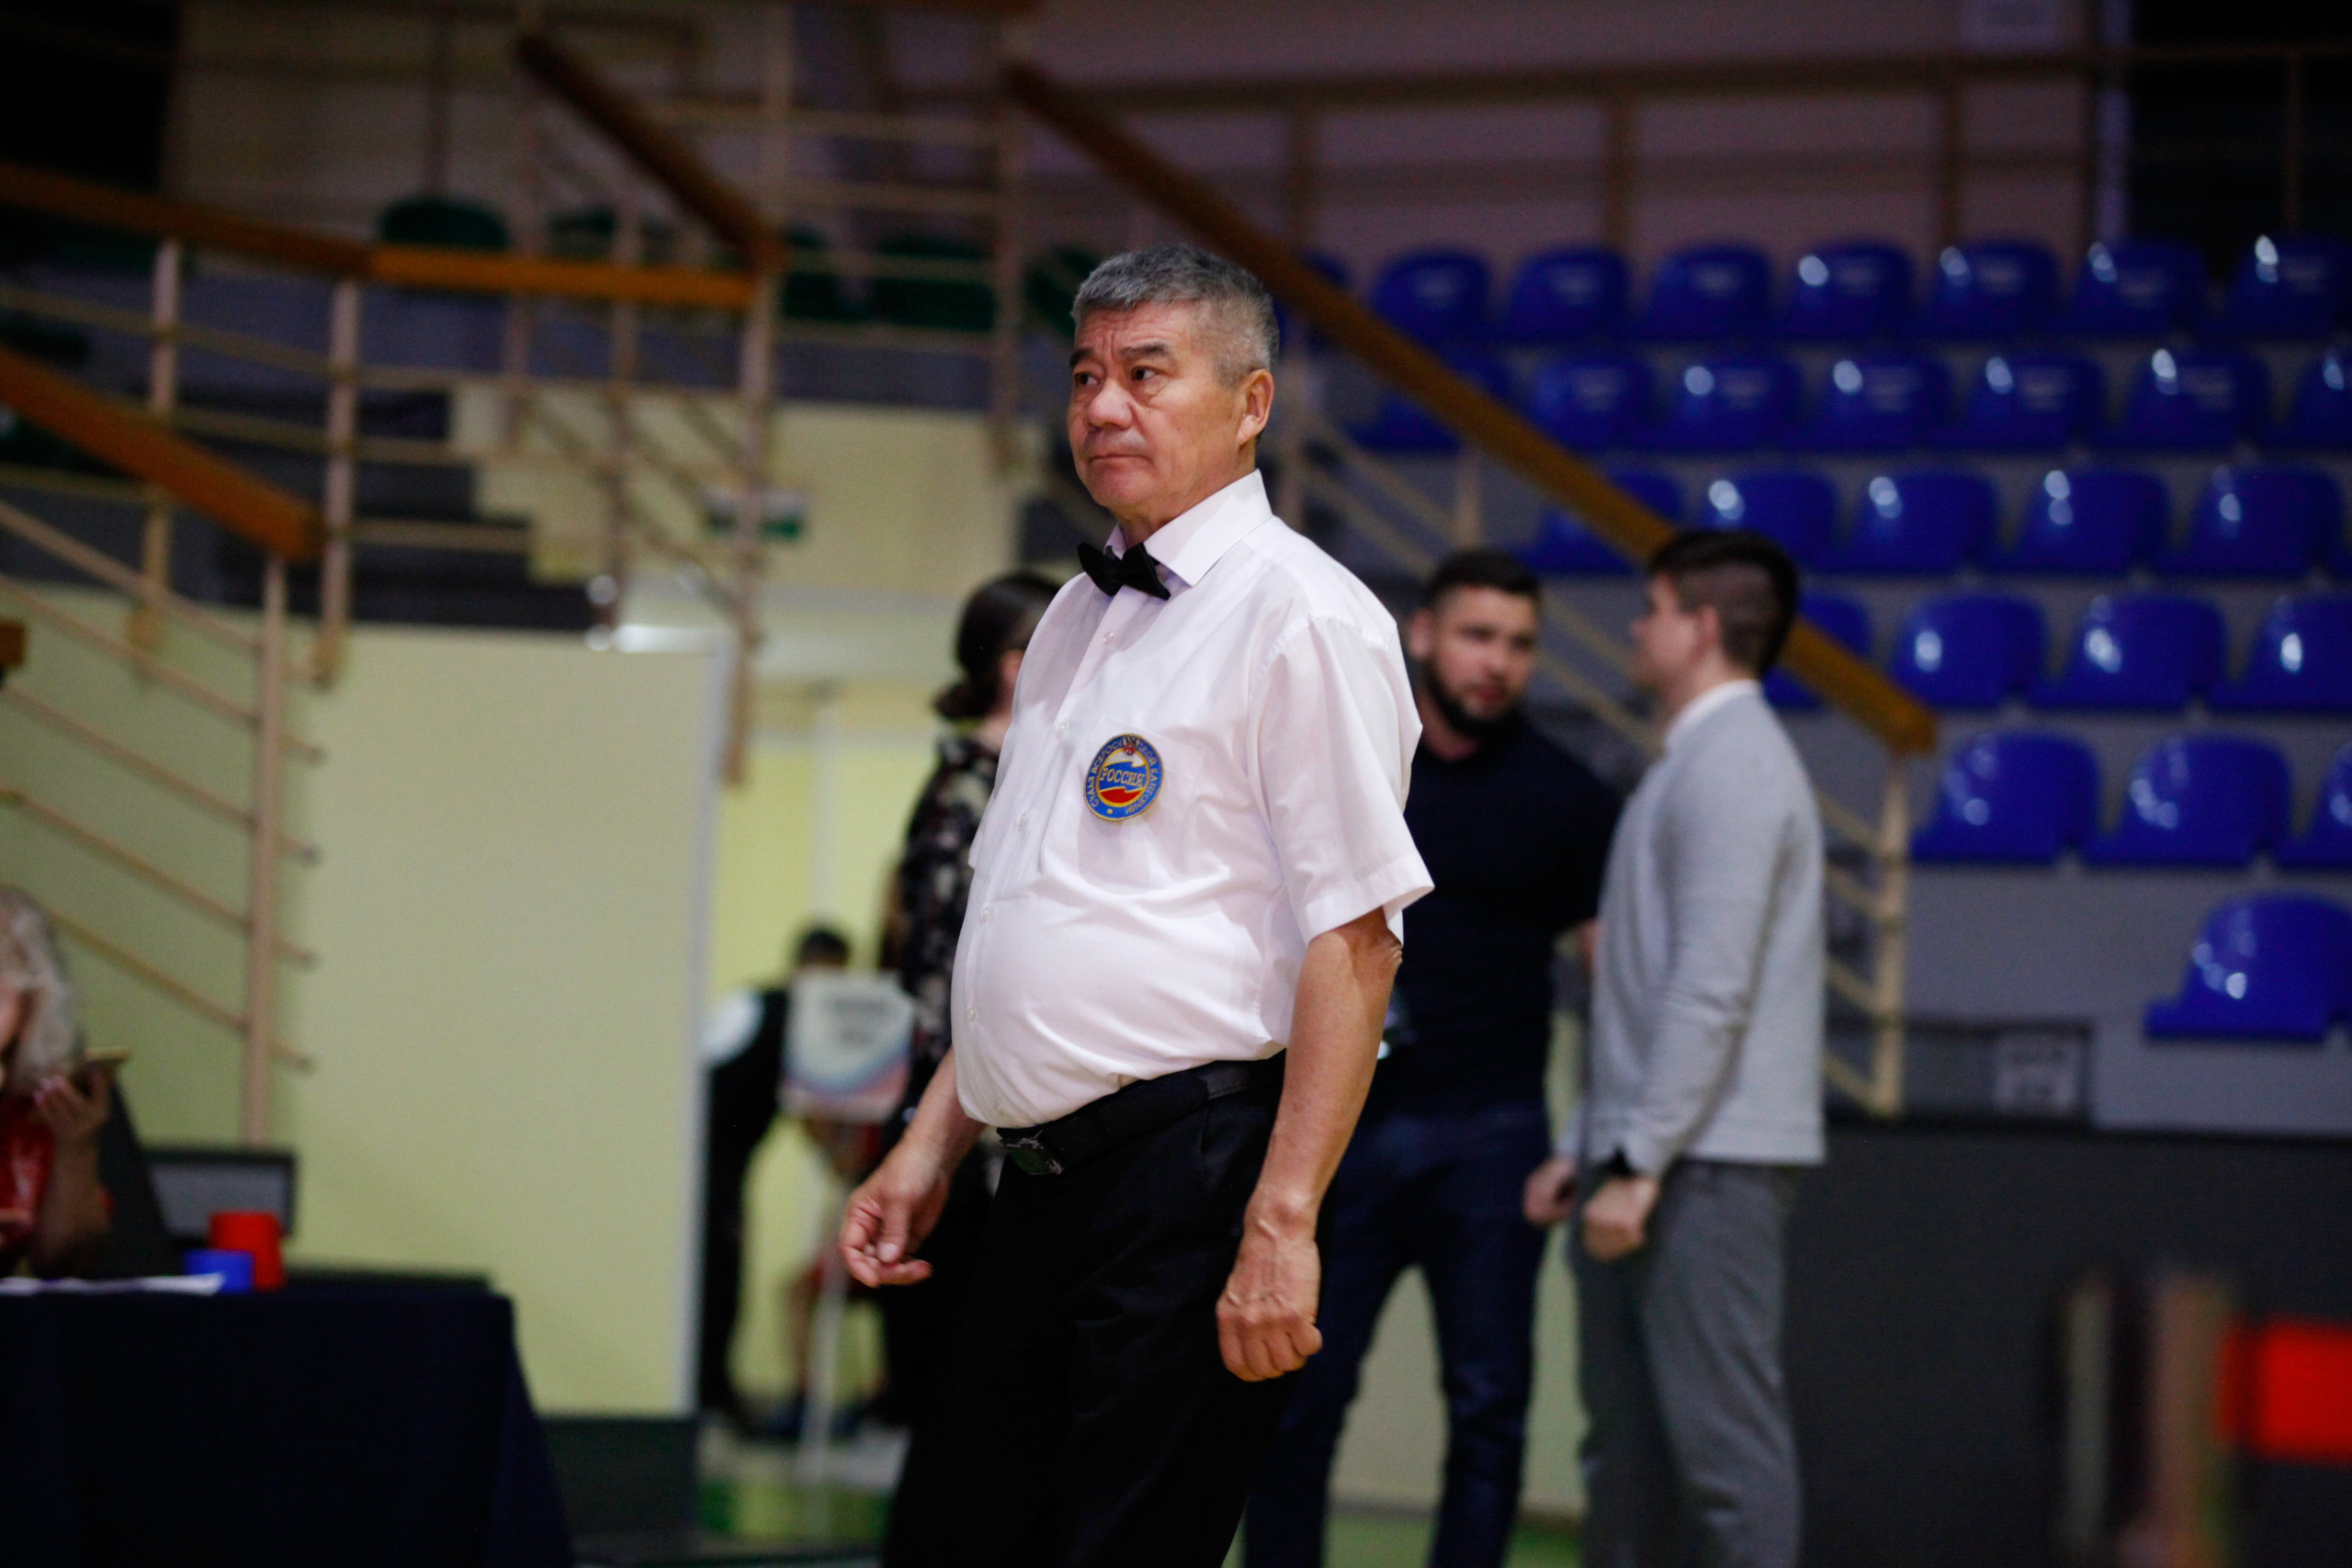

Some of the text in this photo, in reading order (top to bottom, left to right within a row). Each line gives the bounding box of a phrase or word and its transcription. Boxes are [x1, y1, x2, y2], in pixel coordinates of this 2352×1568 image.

[1086, 776, 1099, 807] СУДЬЯ
[1125, 768, 1159, 815] КАТЕГОРИИ
[1100, 768, 1146, 788] РОССИЯ
